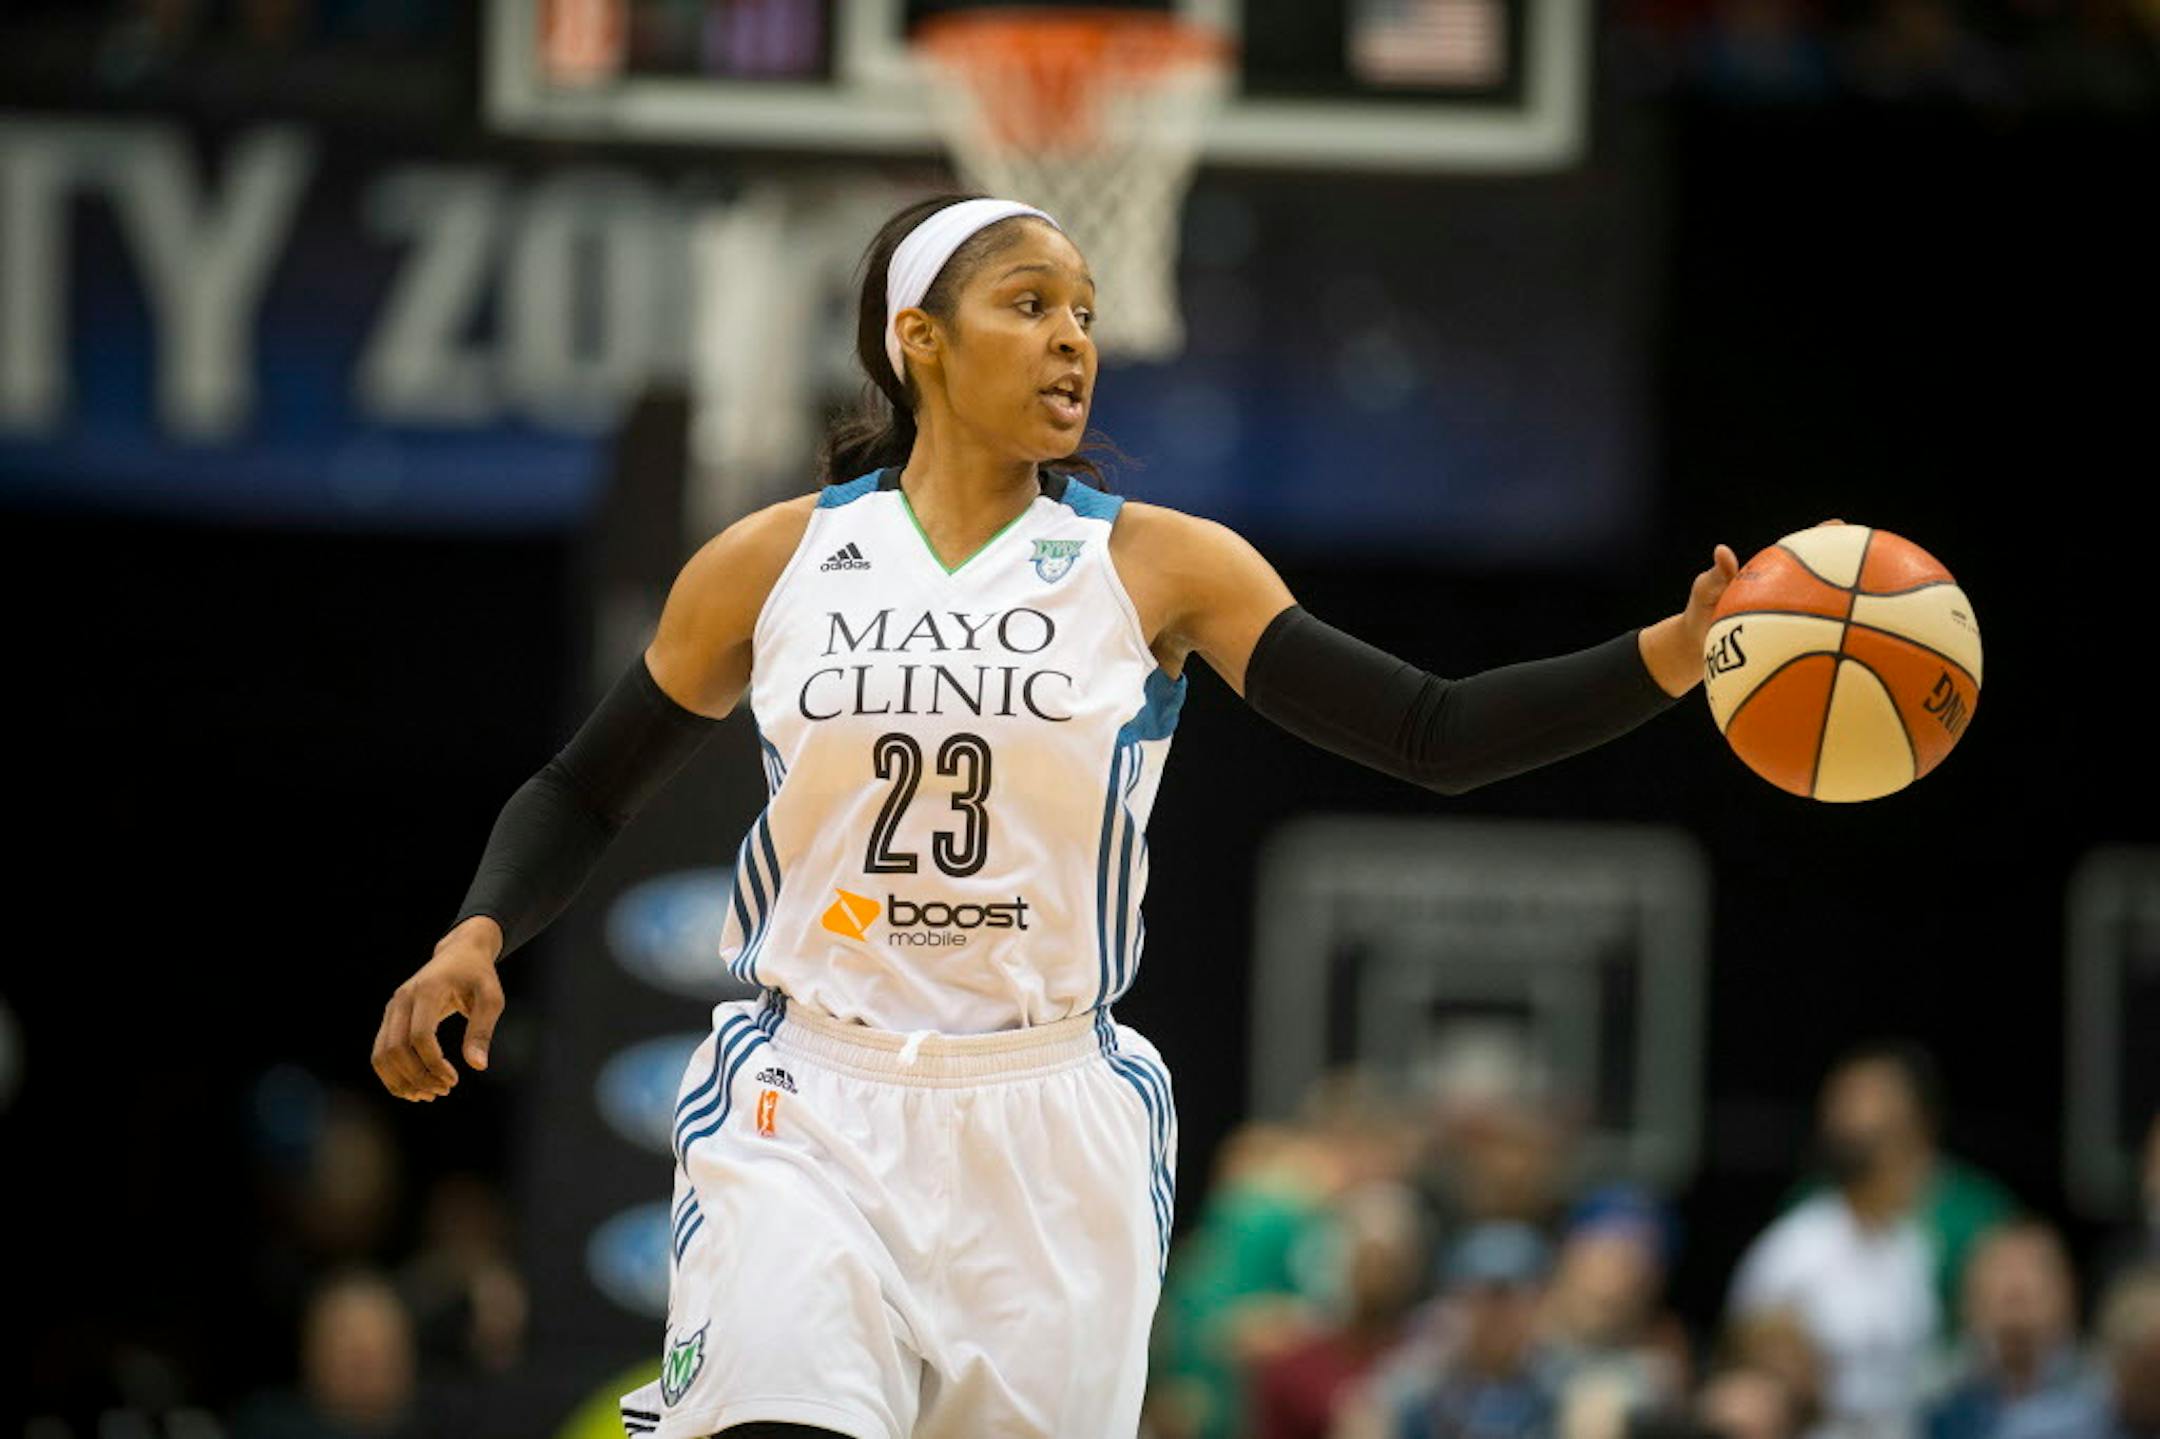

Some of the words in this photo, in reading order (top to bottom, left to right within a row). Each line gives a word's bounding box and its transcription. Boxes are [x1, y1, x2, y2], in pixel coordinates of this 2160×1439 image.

[820, 559, 872, 573] adidas
[821, 608, 1056, 657] MAYO
[799, 664, 1073, 722] CLINIC
[863, 732, 992, 878] 23
[888, 893, 1029, 930] boost
[889, 931, 967, 946] mobile
